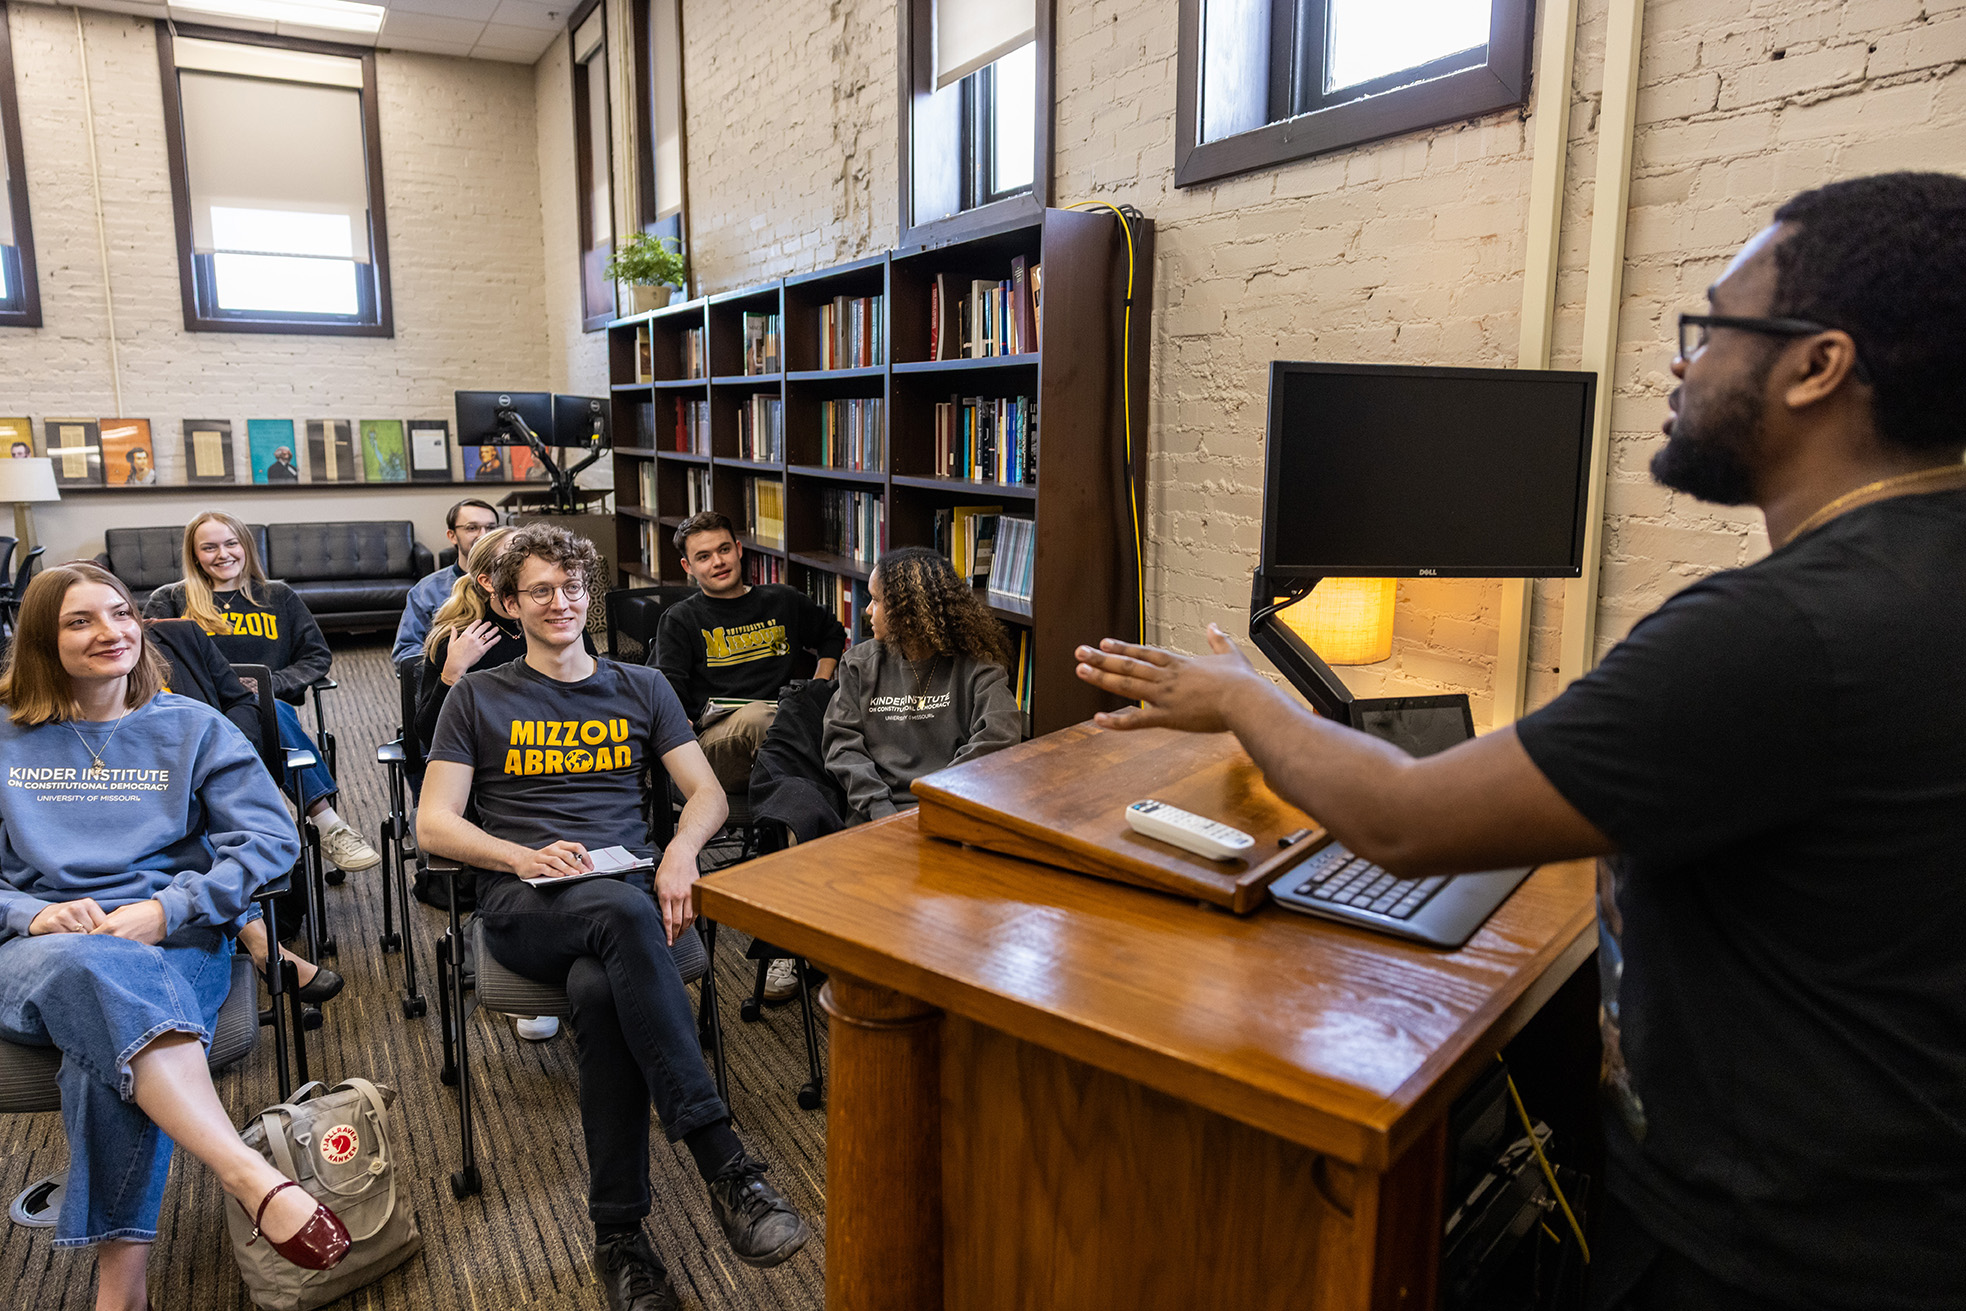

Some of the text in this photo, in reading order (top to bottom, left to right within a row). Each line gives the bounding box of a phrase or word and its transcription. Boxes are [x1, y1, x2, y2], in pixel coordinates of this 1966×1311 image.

[1418, 568, 1438, 576] DELL
[701, 625, 786, 659] MISSOURI
[870, 696, 905, 706] KINDER
[510, 718, 629, 747] MIZZOU
[504, 745, 631, 776] ABROAD
[9, 766, 169, 782] KINDER INSTITUTE
[7, 779, 169, 791] ON CONSTITUTIONAL DEMOCRACY
